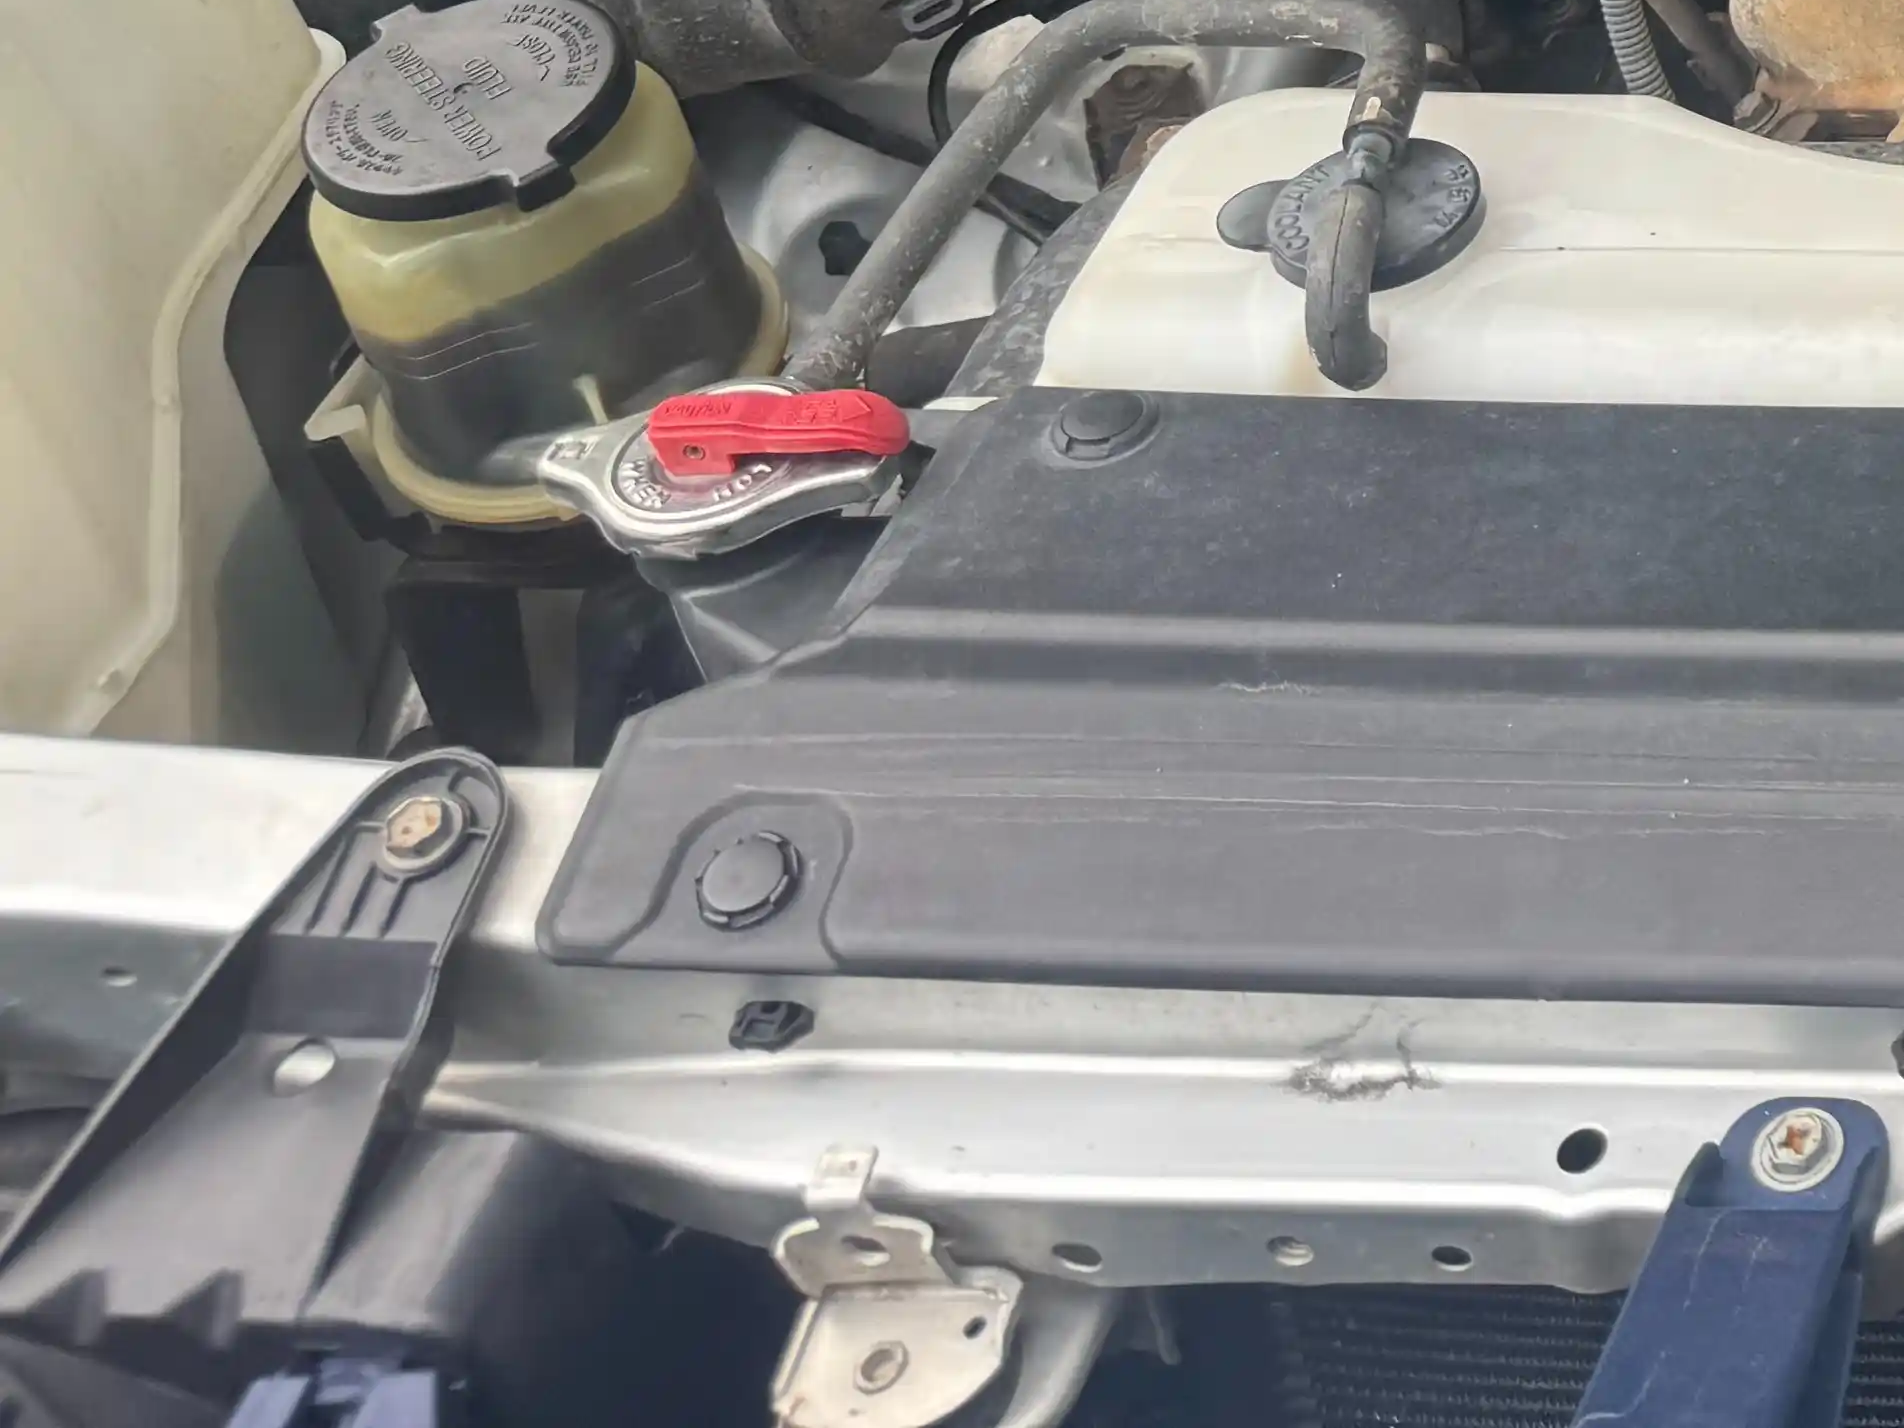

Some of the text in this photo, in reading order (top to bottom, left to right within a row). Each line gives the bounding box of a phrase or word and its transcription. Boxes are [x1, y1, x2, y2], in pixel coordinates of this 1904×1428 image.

[384, 42, 503, 162] POWER STEERING
[462, 55, 513, 101] FLUID
[1274, 164, 1330, 251] COOLANT
